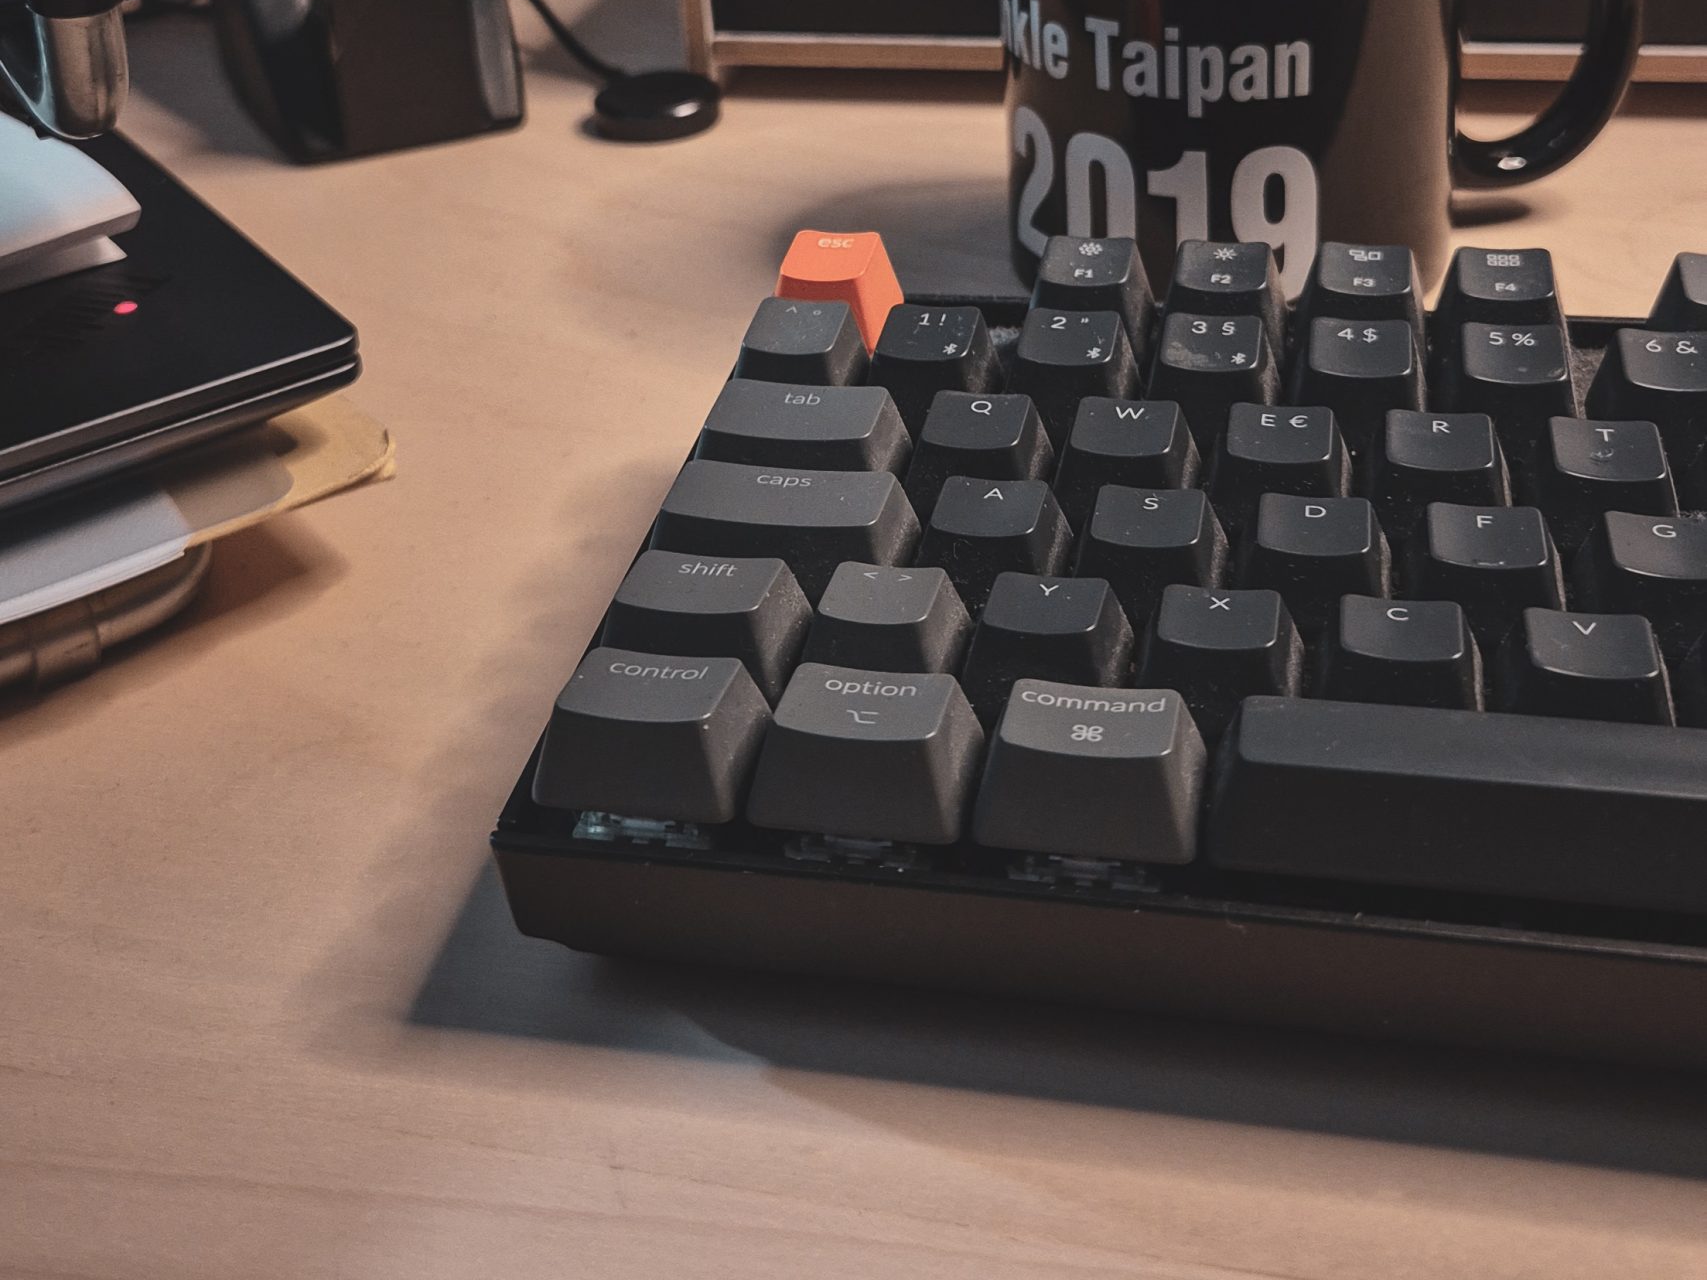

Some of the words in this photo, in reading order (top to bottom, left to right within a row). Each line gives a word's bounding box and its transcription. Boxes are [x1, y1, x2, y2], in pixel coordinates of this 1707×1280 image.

[1085, 17, 1312, 118] Taipan
[1014, 106, 1319, 301] 2019
[817, 237, 854, 248] esc
[1073, 268, 1093, 278] F1
[1210, 273, 1232, 284] F2
[1353, 277, 1375, 288] F3
[1494, 282, 1517, 292] F4
[784, 392, 821, 406] tab
[970, 400, 993, 416] Q
[1115, 406, 1145, 420] W
[1260, 413, 1276, 427] E
[1432, 420, 1450, 433] R
[1595, 428, 1615, 442] T
[756, 474, 812, 488] caps
[983, 487, 1004, 501] A
[1143, 497, 1159, 510] S
[1304, 505, 1327, 518] D
[1476, 515, 1493, 529] F
[1651, 524, 1677, 539] G
[678, 562, 737, 577] shift
[1039, 583, 1059, 597] Y
[1209, 596, 1230, 611] X
[1386, 607, 1409, 621] C
[1572, 620, 1597, 636] V
[609, 662, 709, 680] control
[824, 679, 917, 697] option
[1021, 690, 1166, 713] command
